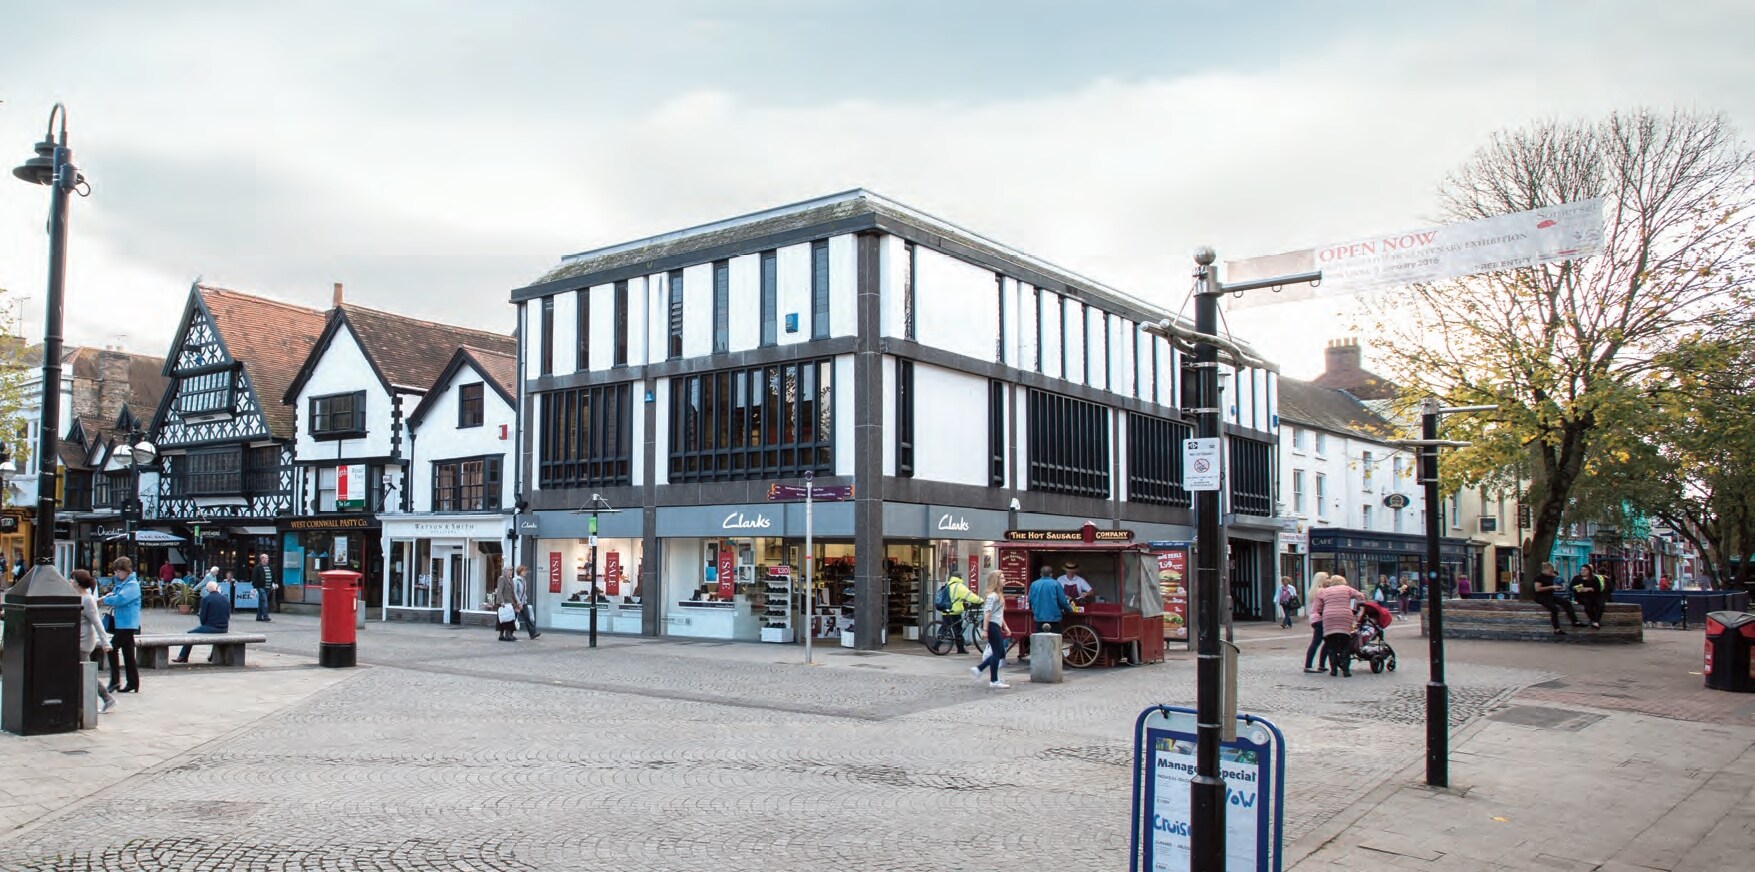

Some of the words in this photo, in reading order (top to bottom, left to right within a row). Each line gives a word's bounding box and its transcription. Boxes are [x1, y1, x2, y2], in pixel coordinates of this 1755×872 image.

[1537, 203, 1598, 219] Somerset
[1319, 241, 1375, 263] OPEN
[1381, 231, 1438, 253] NOW
[1465, 233, 1528, 249] EXHIBITION
[1501, 257, 1532, 268] ENTRY
[306, 519, 339, 528] CORNWALL
[340, 519, 357, 527] PASTY
[722, 510, 771, 529] Clarks
[938, 513, 969, 531] Clarks
[1010, 531, 1026, 539] THE
[1028, 531, 1045, 539] HOT
[1047, 531, 1081, 539] SAUSAGE
[1096, 531, 1128, 539] COMPANY
[551, 560, 559, 585] SALE
[608, 560, 617, 587] SALE
[721, 561, 731, 590] SALE
